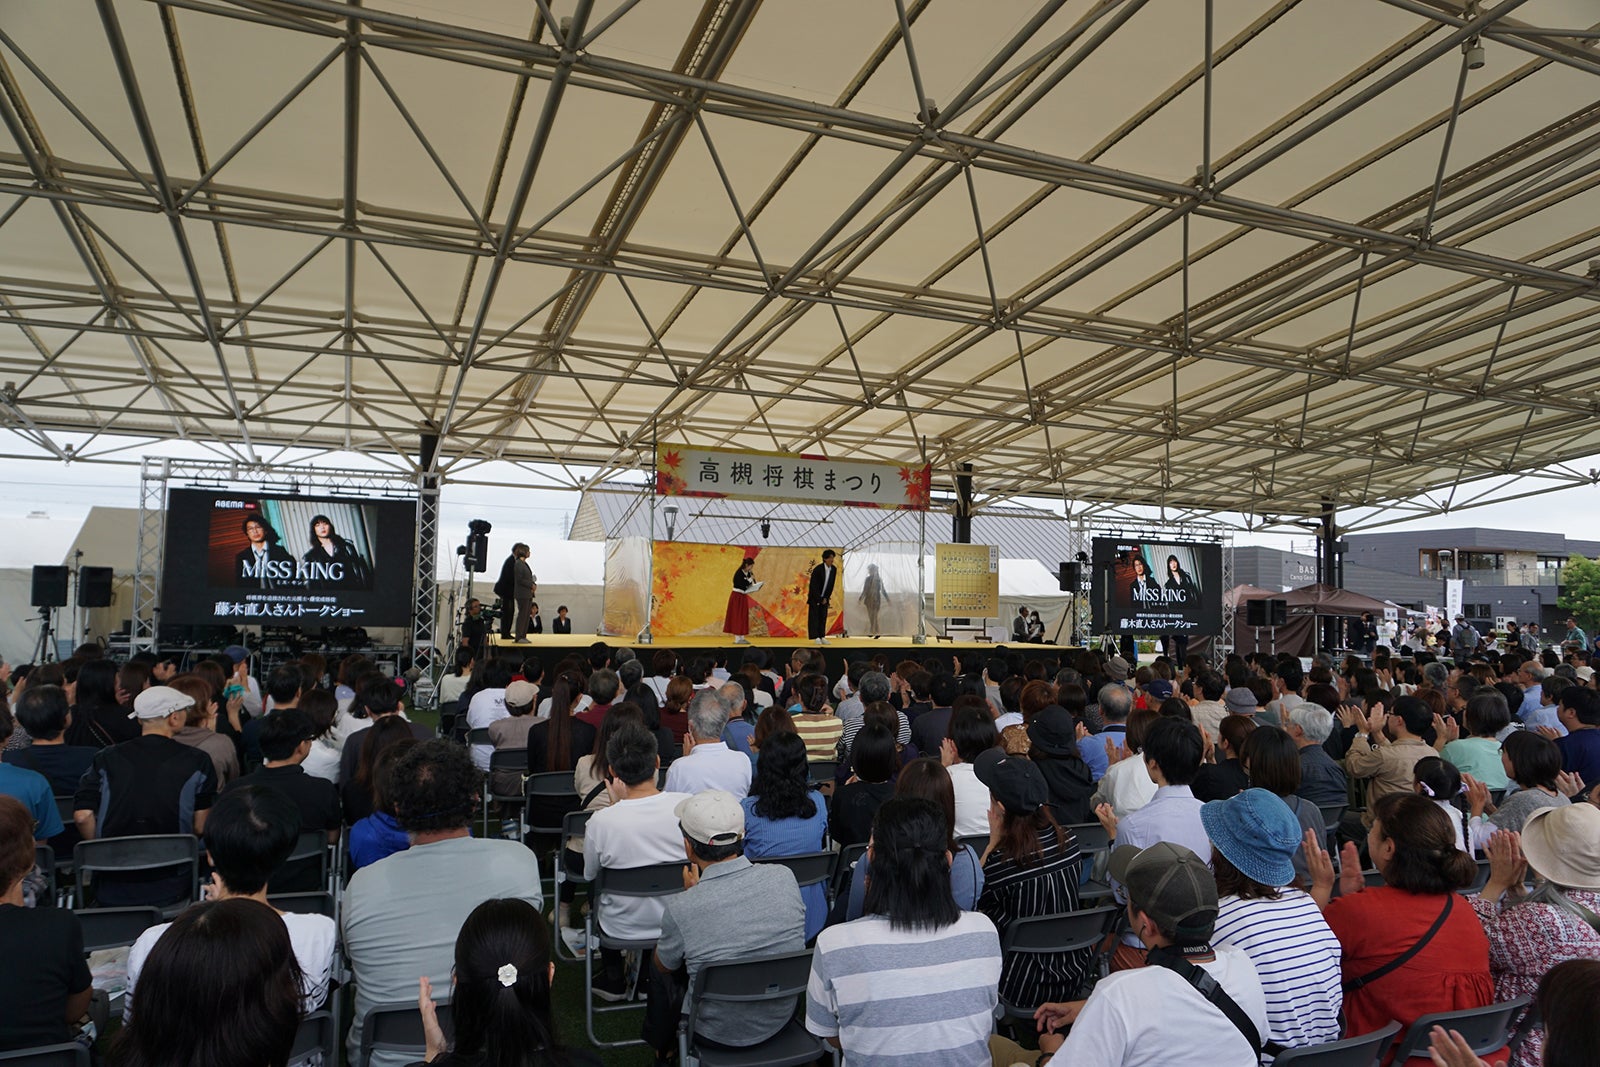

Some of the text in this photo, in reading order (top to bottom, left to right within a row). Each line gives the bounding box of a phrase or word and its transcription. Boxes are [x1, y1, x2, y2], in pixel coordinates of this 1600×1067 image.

[700, 460, 881, 494] 高槻将棋まつり
[215, 500, 244, 509] ABEMA
[242, 559, 345, 581] MISS KING
[1133, 587, 1187, 602] MISS KING
[213, 601, 365, 617] 藤木直人さんトークショー
[1183, 944, 1208, 953] Canon
